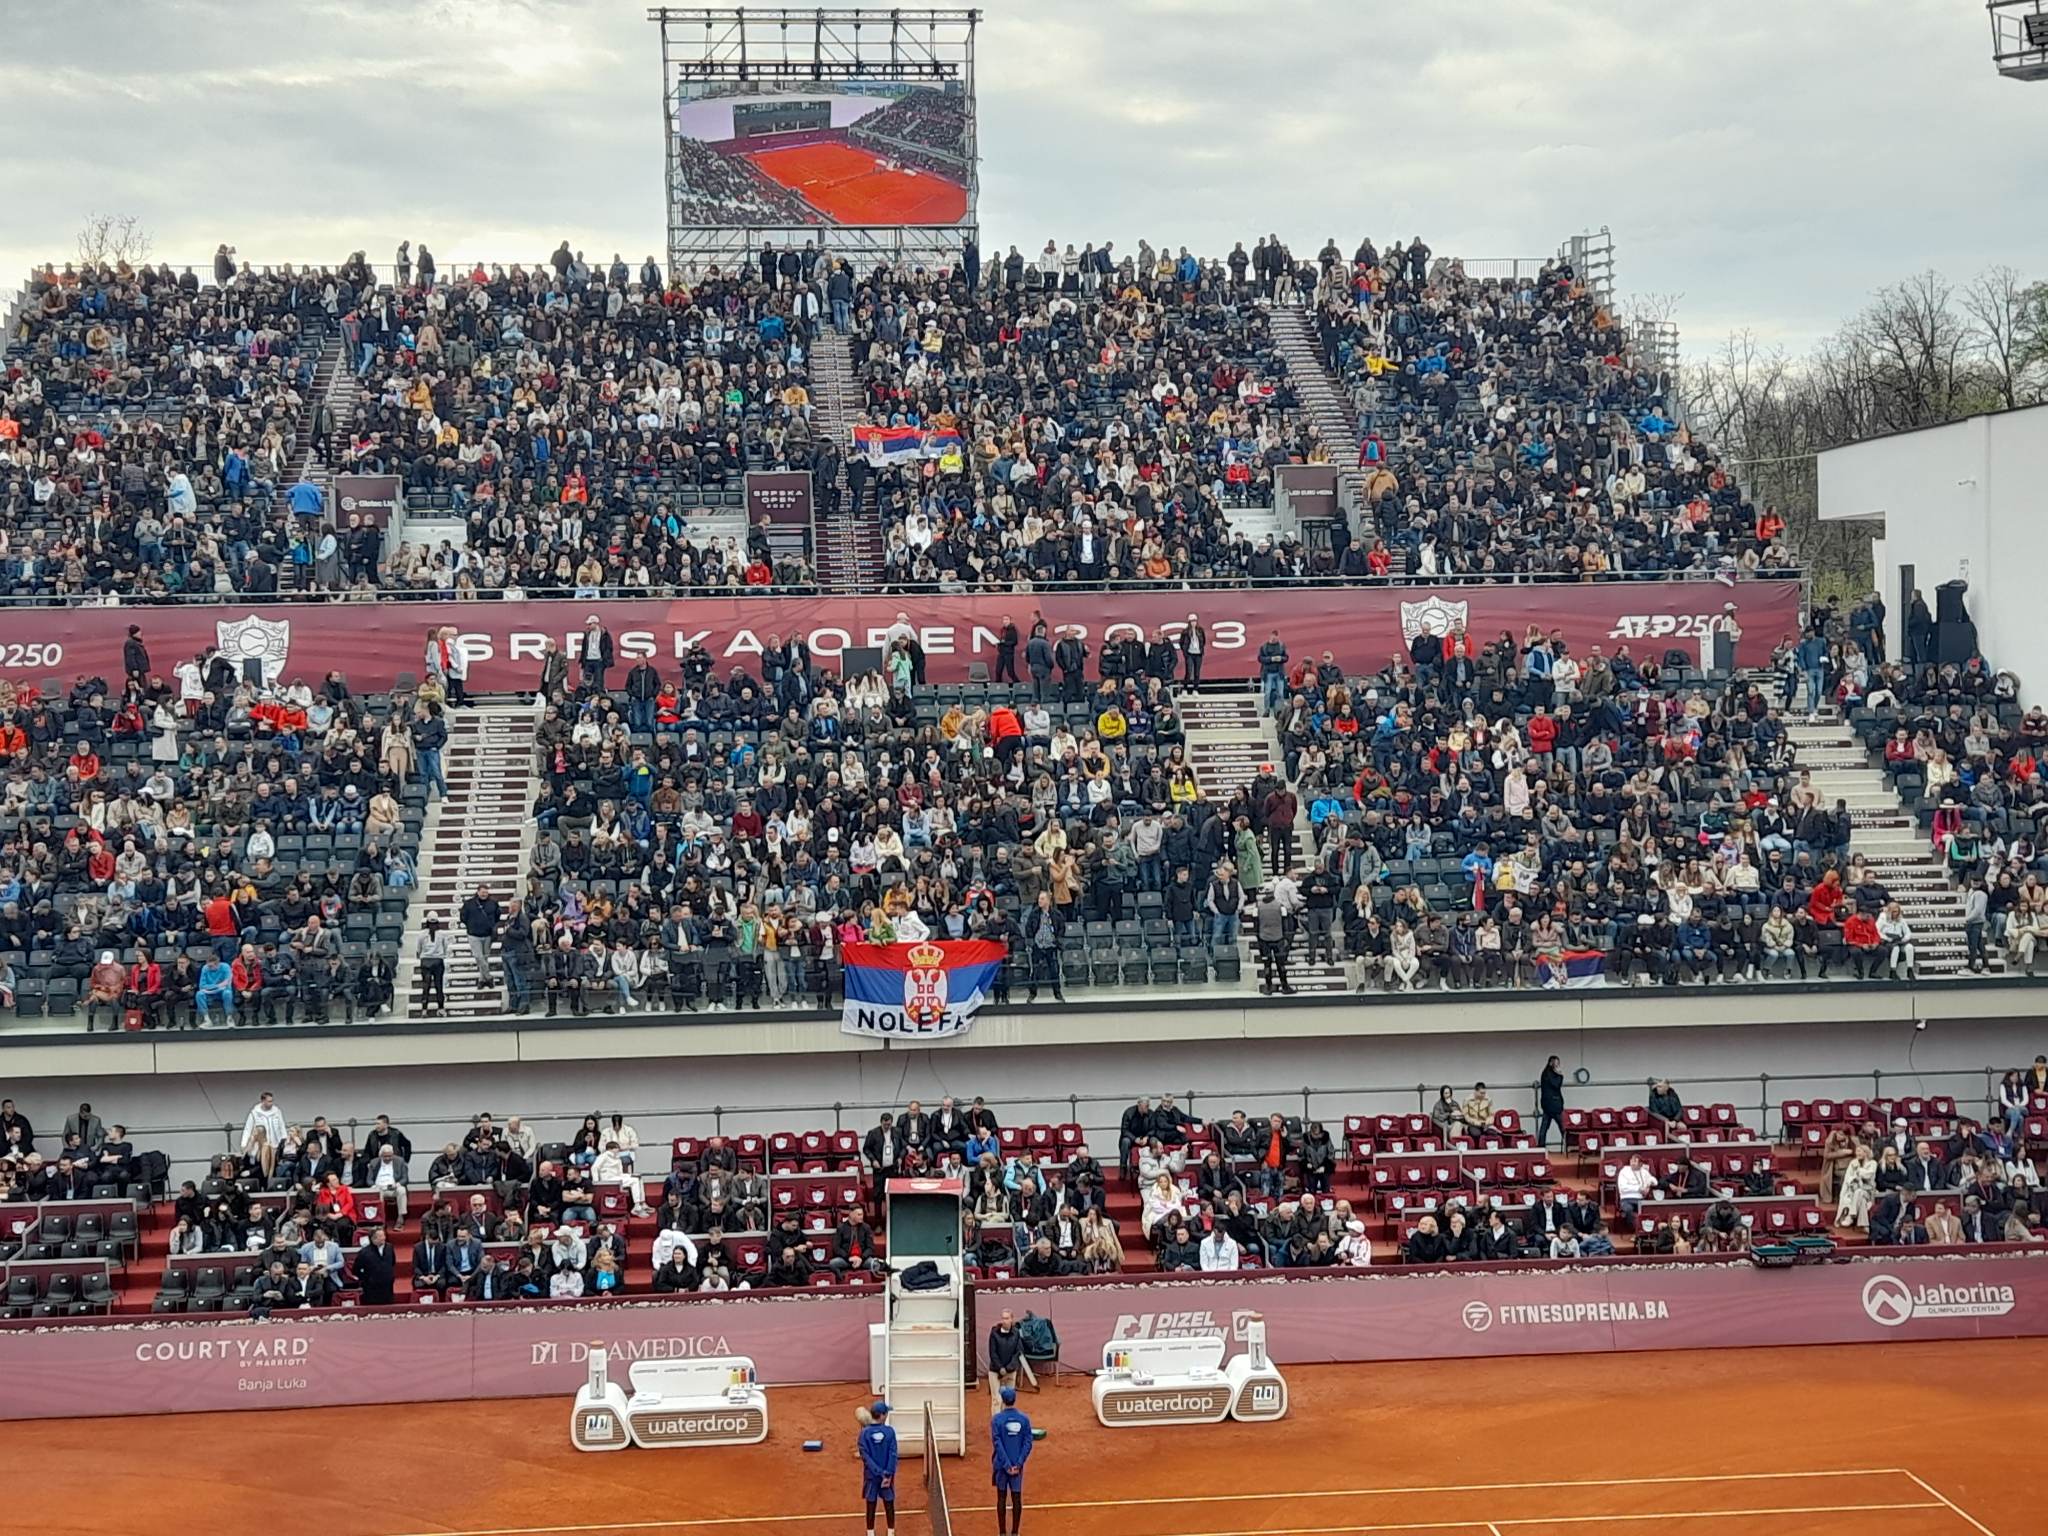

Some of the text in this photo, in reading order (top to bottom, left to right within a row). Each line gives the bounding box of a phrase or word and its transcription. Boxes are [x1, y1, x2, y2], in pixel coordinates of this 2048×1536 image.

[1913, 1282, 2015, 1305] Jahorina
[1156, 1311, 1216, 1329] DIZEL
[1500, 1300, 1669, 1324] FITNESOPREMA.BA
[136, 1337, 309, 1361] COURTYARD
[570, 1336, 731, 1363] DAMEDICA
[255, 1358, 308, 1367] MARRIOTT
[238, 1378, 307, 1393] Banja Luka
[1116, 1394, 1213, 1413] waterdrop
[648, 1414, 748, 1435] waterdrop
